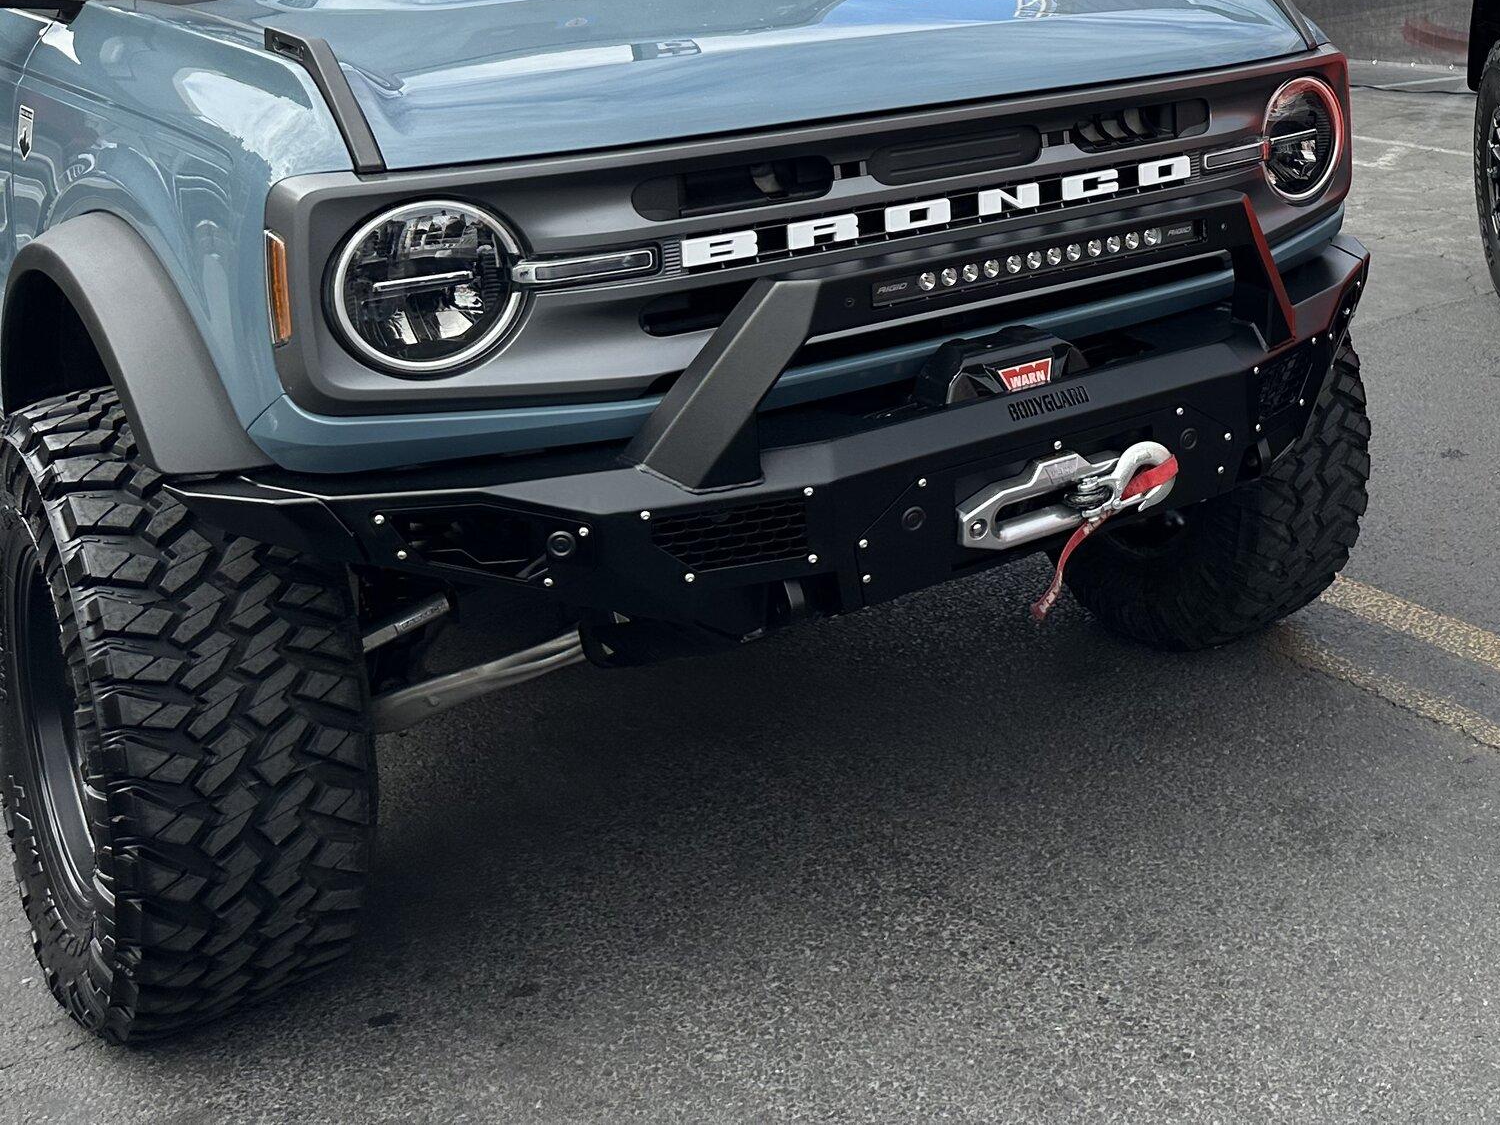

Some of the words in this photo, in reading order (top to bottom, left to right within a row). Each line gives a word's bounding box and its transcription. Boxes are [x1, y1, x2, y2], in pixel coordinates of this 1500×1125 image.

[681, 155, 1192, 268] BRONCO
[1167, 225, 1193, 237] RIGID
[877, 282, 908, 295] RIGID
[1010, 369, 1046, 388] WARN
[1007, 385, 1090, 422] BODYGUARD
